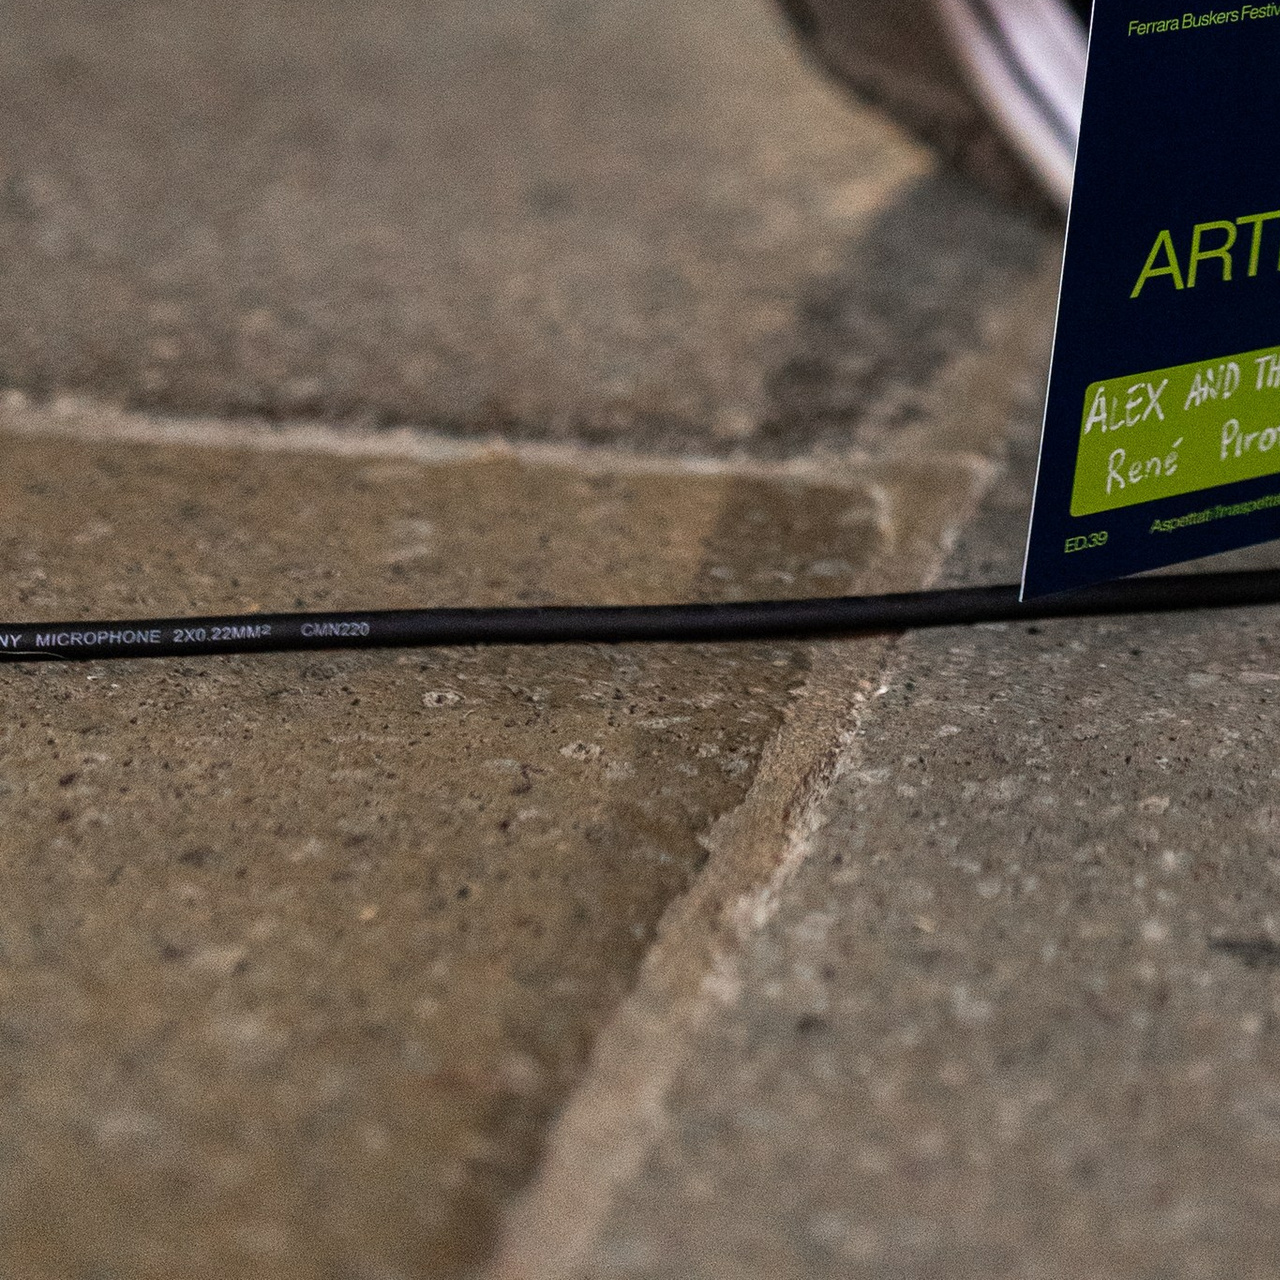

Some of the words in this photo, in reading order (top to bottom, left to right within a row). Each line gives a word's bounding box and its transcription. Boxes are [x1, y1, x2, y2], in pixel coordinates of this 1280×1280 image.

[1128, 18, 1180, 36] Ferrara
[1181, 9, 1240, 29] Buskers
[1084, 378, 1169, 435] ALEX
[1183, 361, 1241, 411] AND
[35, 629, 162, 647] MICROPHONE
[300, 621, 371, 638] CMN220
